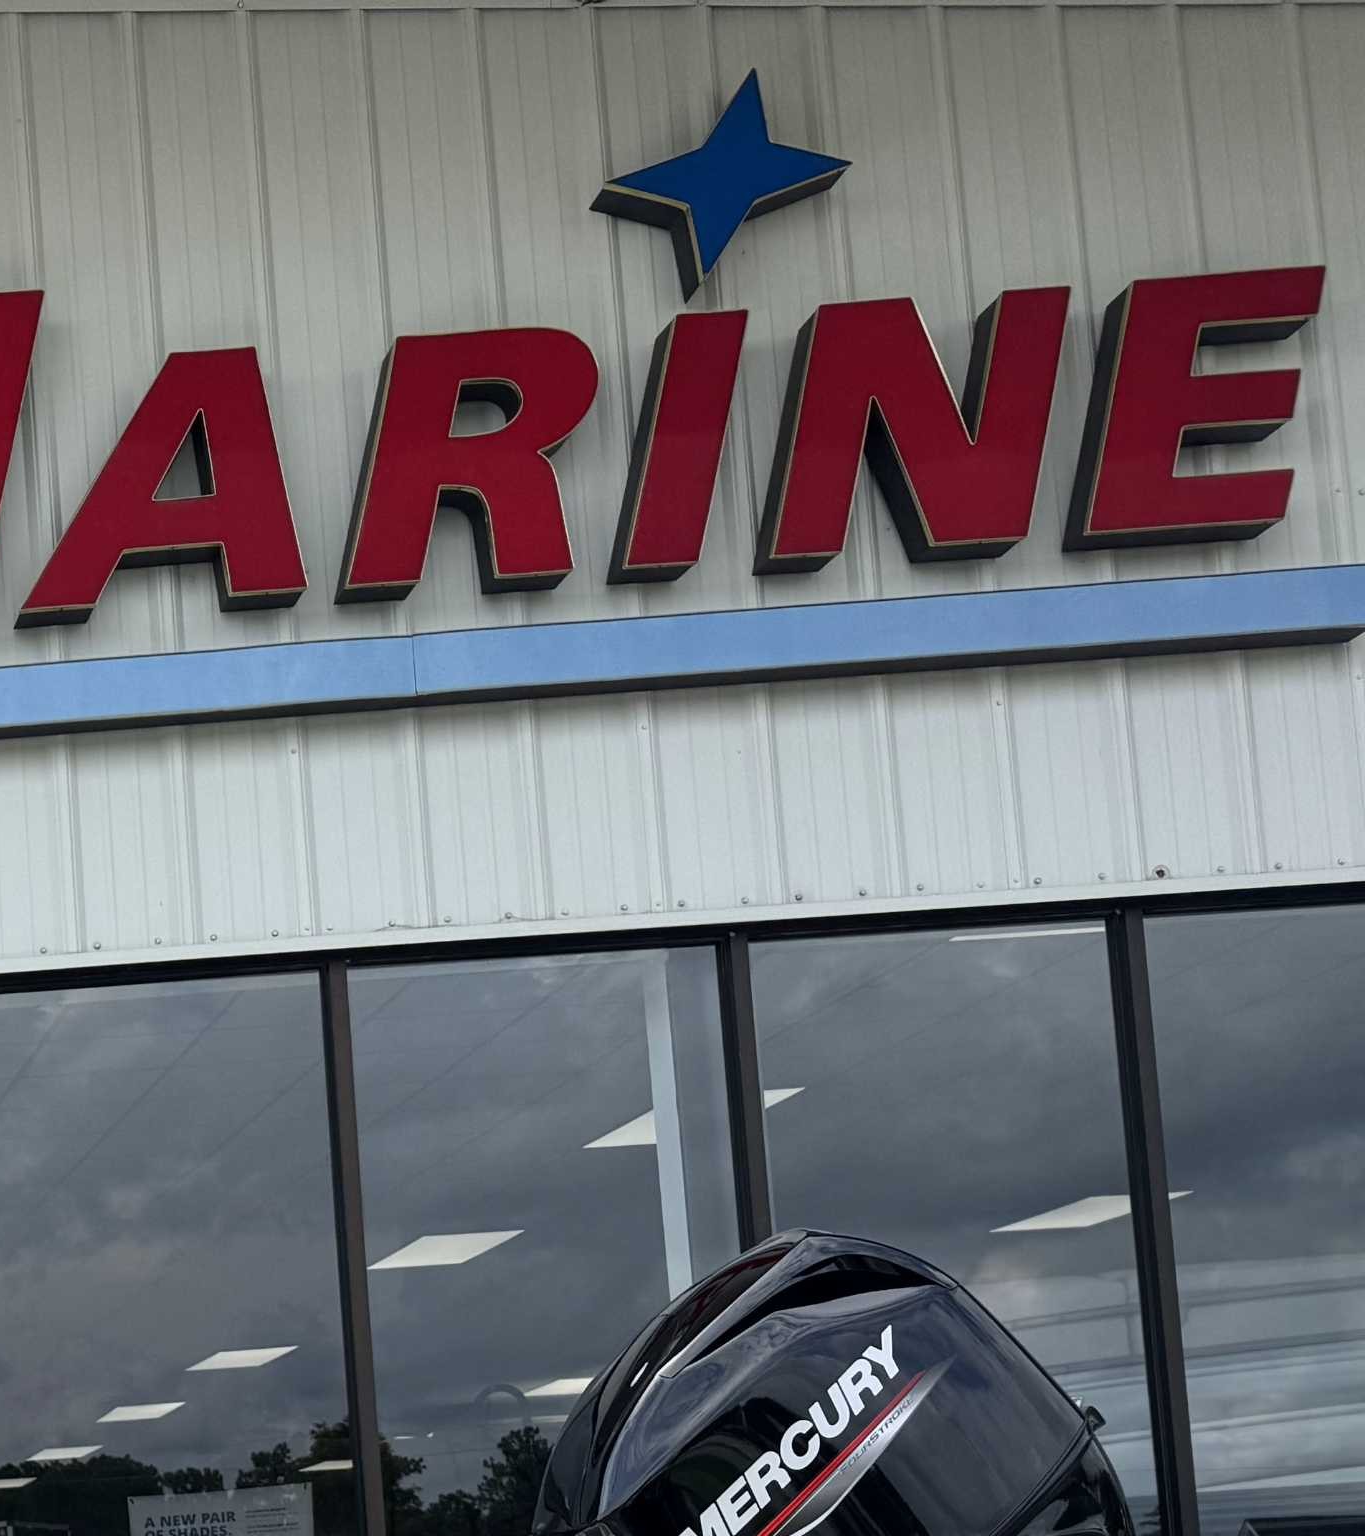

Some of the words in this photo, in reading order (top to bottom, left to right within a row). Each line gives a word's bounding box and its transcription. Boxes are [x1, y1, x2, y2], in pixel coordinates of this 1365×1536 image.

[145, 1516, 155, 1528] A
[160, 1513, 196, 1527] NEW
[201, 1511, 236, 1524] PAIR
